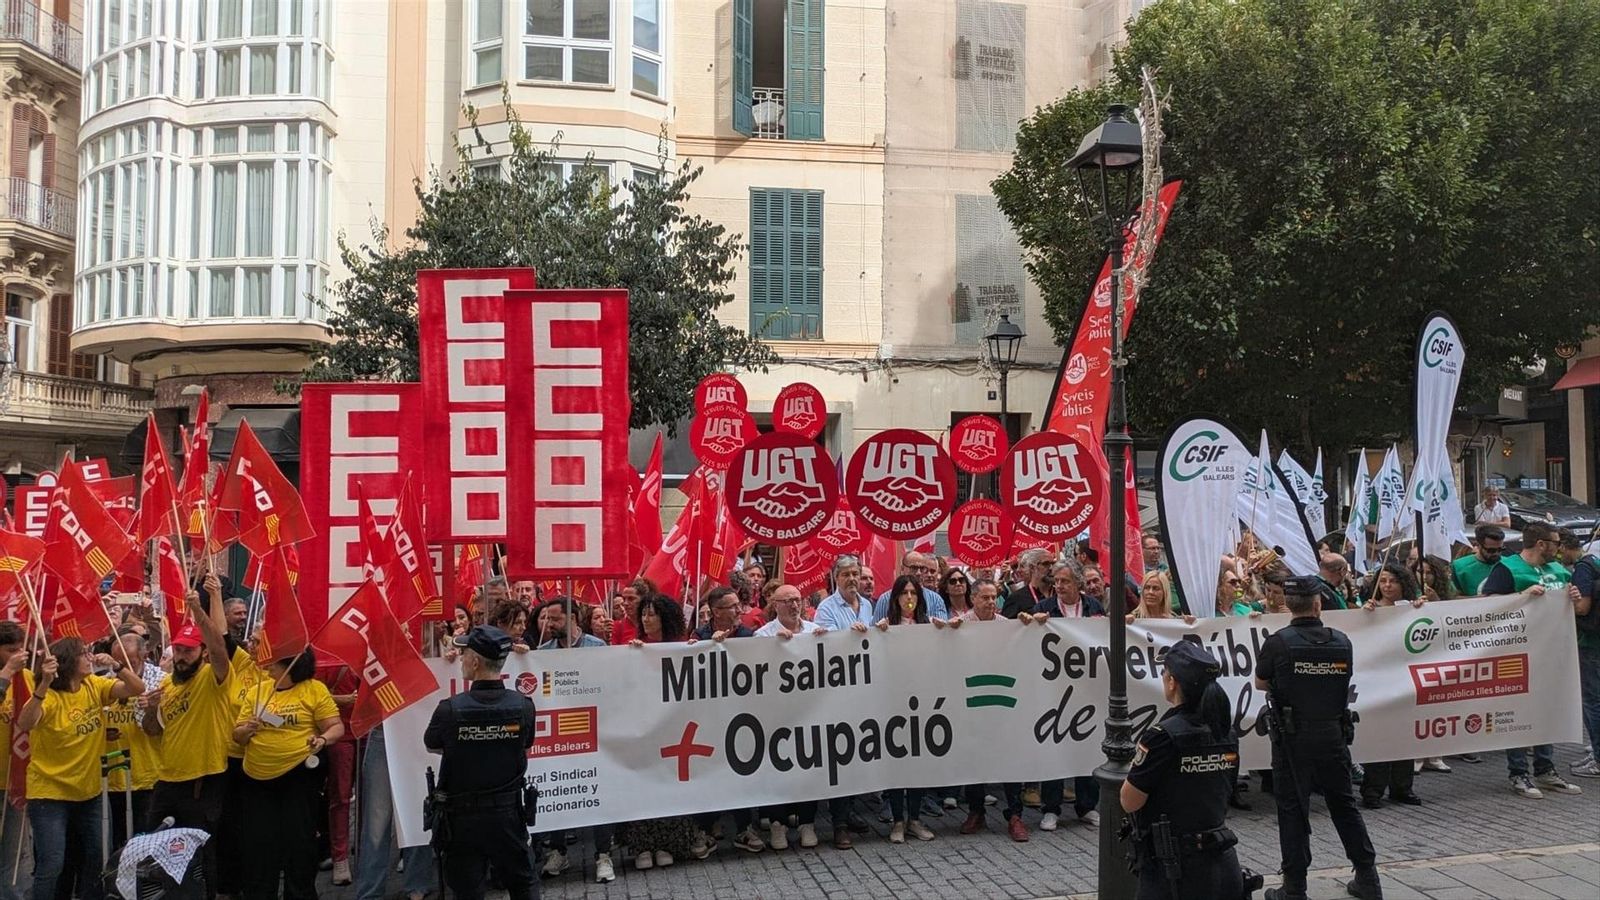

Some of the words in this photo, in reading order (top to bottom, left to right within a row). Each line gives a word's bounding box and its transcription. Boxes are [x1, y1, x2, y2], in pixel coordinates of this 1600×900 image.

[1431, 339, 1453, 356] CSIF
[705, 387, 736, 404] UGT
[784, 396, 814, 416] UGT
[532, 302, 603, 568] CCOO
[703, 418, 743, 438] UGT
[963, 429, 996, 448] UGT
[862, 442, 939, 482] UGT
[1184, 445, 1229, 464] CSIF
[742, 446, 818, 492] UGT
[1014, 443, 1082, 490] UGT
[1203, 473, 1235, 481] BALEARS
[742, 516, 775, 539] ILLES
[776, 509, 827, 540] BALEARS
[859, 505, 890, 531] ILLES
[892, 507, 943, 532] BALEARS
[962, 515, 1000, 536] UGT
[1019, 514, 1050, 534] ILLES
[1051, 503, 1094, 534] BALEARS
[1445, 615, 1483, 626] Central
[1485, 609, 1525, 622] Sindical
[1411, 627, 1440, 642] CSIF
[1447, 625, 1519, 640] Independiente
[1520, 623, 1527, 633] y
[1448, 641, 1462, 651] de
[1464, 634, 1528, 649] Funcionarios
[661, 650, 769, 703] Millor
[779, 638, 871, 694] salari
[1294, 661, 1337, 669] POLICIA
[554, 671, 580, 679] Serveis
[554, 679, 580, 688] Públics
[1416, 661, 1493, 688] CCOO
[572, 685, 602, 696] Balears
[1427, 692, 1446, 702] área
[1446, 689, 1475, 701] pública
[1475, 686, 1494, 696] Illes
[1494, 683, 1524, 694] Balears
[1034, 685, 1097, 744] de
[457, 732, 520, 741] NACIONAL
[458, 726, 507, 734] POLICIA
[1414, 715, 1461, 740] UGT
[554, 741, 591, 753] Balears
[725, 695, 953, 787] Ocupació
[1180, 762, 1236, 773] NACIONAL
[1181, 753, 1226, 765] POLICIA
[527, 772, 547, 785] tral
[550, 767, 597, 782] Sindical
[537, 784, 588, 799] endiente
[591, 783, 599, 795] y
[538, 797, 601, 814] ncionarios
